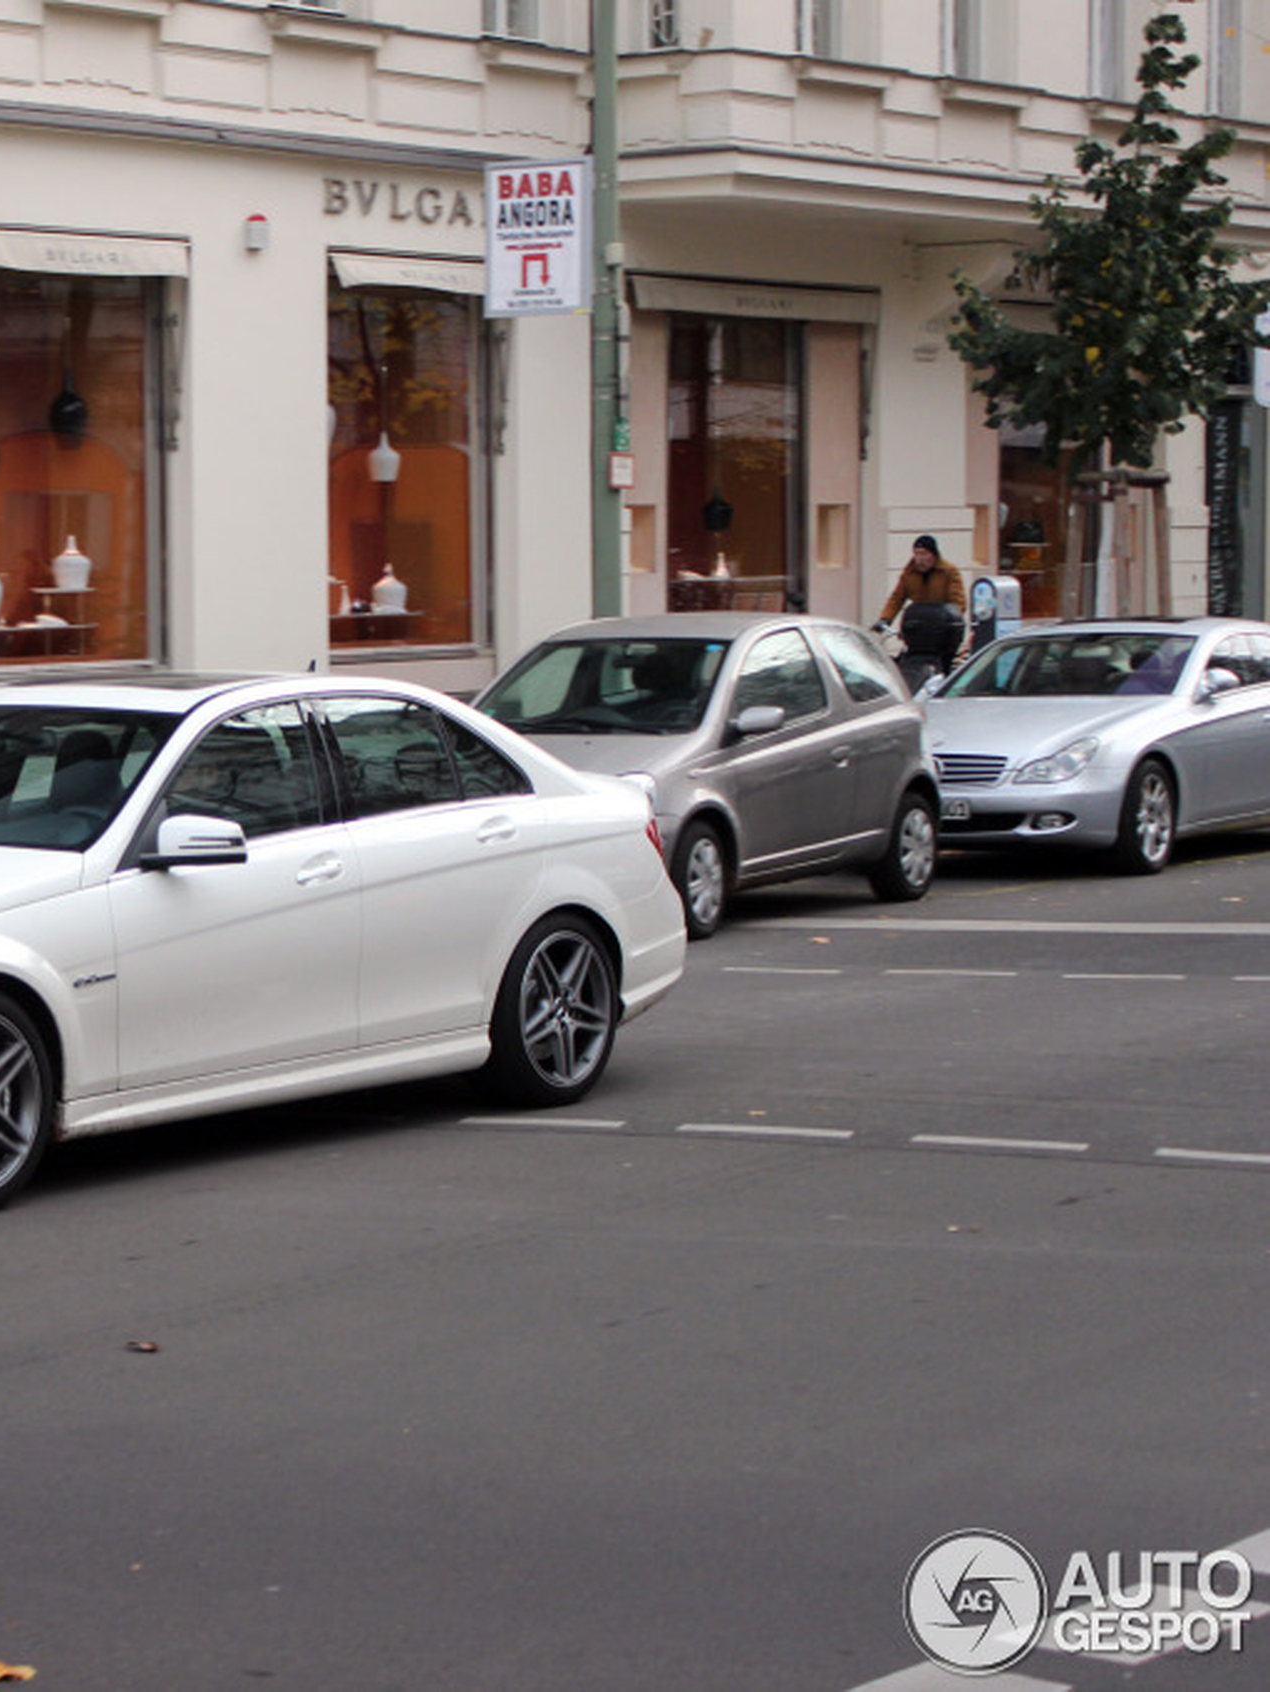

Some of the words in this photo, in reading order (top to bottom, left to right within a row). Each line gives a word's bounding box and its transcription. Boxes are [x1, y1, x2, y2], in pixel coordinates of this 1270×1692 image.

[497, 170, 574, 199] BABA
[322, 177, 487, 228] BVLGA
[496, 200, 574, 229] ANGORA
